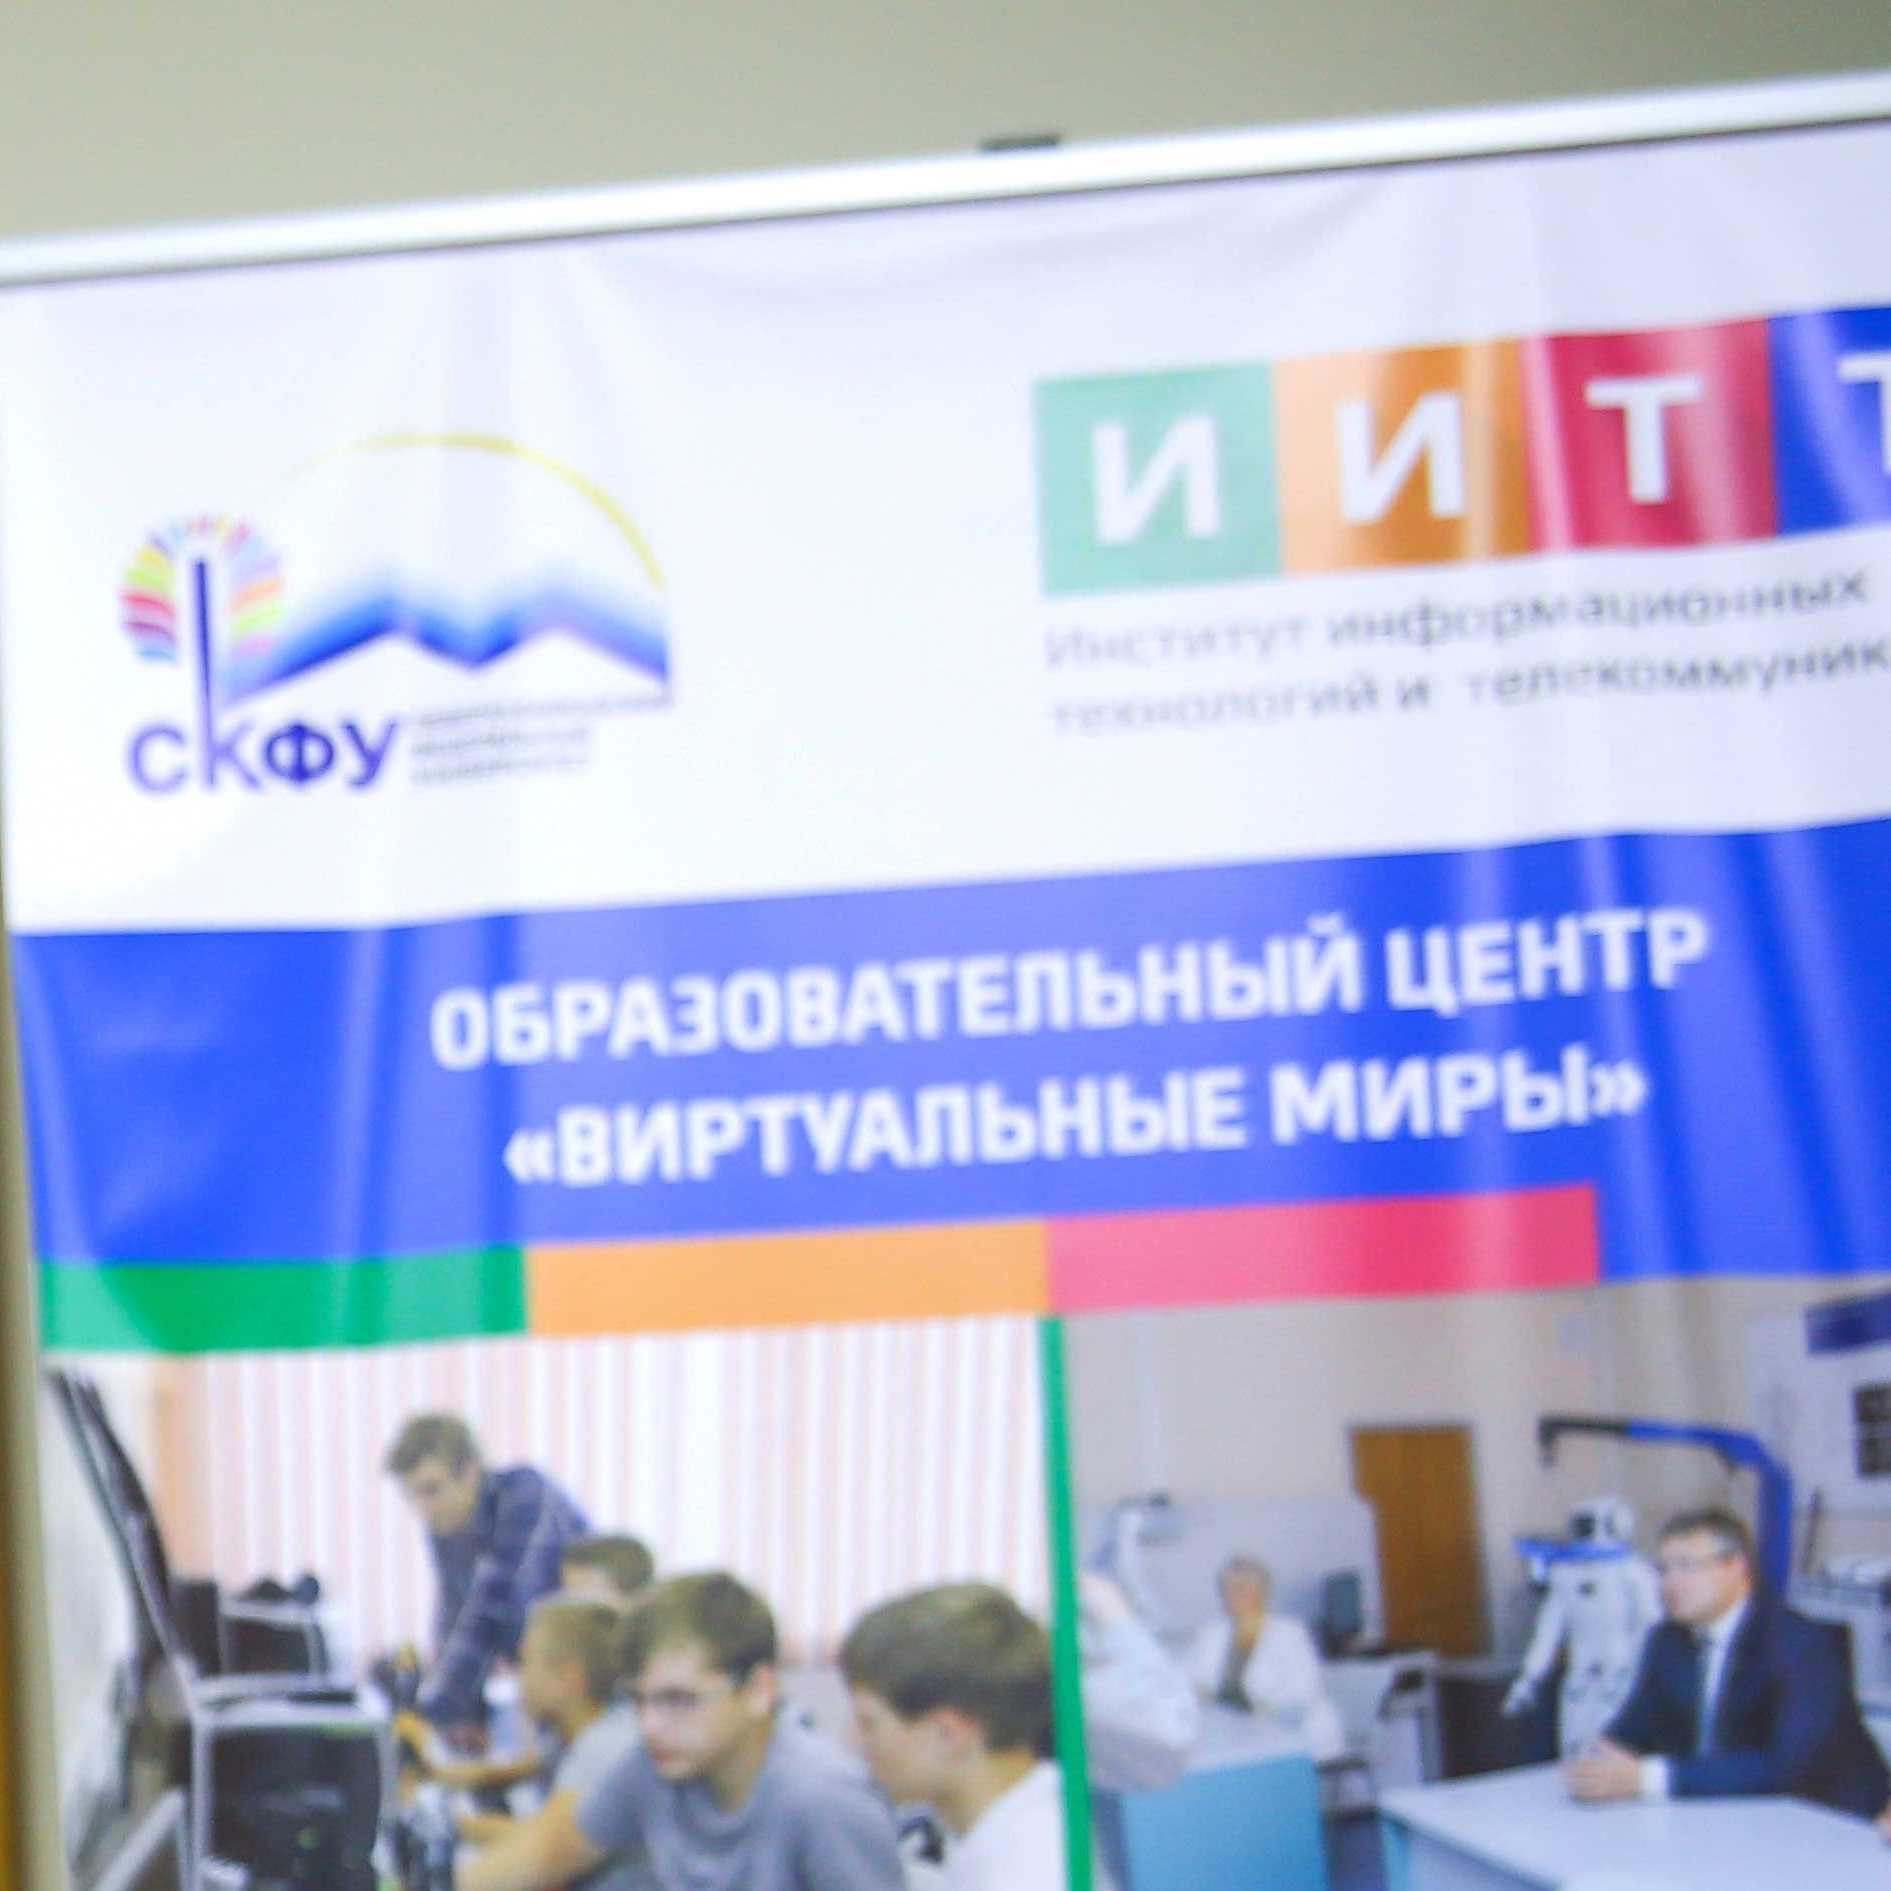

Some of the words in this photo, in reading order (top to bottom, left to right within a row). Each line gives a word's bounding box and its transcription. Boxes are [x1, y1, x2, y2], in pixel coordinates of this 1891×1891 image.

[1046, 616, 1309, 671] Институт
[1328, 565, 1870, 655] информационных
[1053, 670, 1379, 737] технологий
[1397, 677, 1431, 711] и
[430, 912, 1363, 1069] ОБРАЗОВАТЕЛЬНЫЙ
[1387, 906, 1708, 1018] ЦЕНТР
[503, 1068, 1246, 1190] «ВИРТУАЛЬНЫЕ
[1273, 1046, 1648, 1142] МИРЫ»
